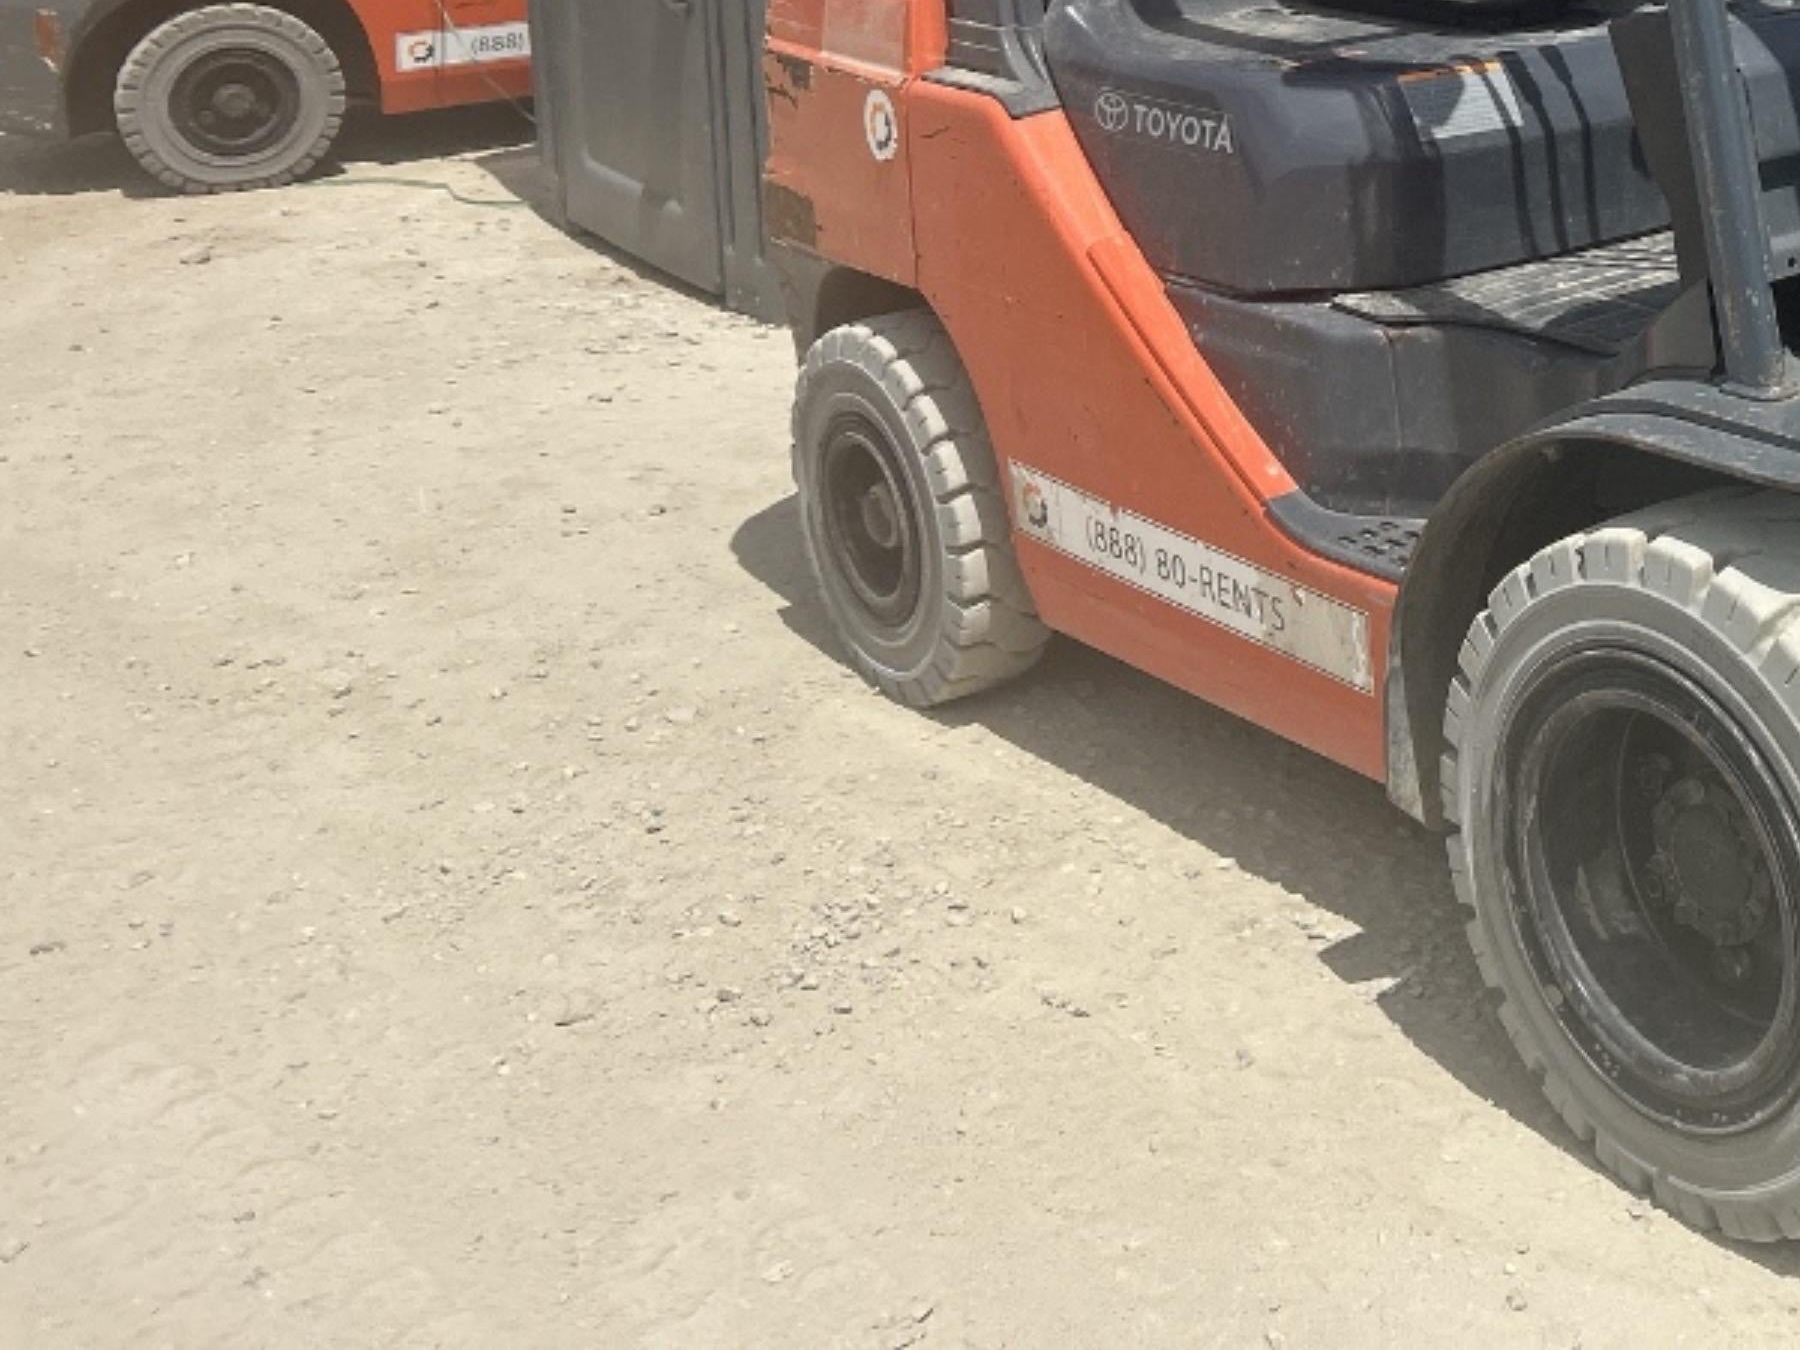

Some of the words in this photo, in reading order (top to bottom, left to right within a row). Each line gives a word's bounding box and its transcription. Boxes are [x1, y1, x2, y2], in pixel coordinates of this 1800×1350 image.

[1133, 103, 1234, 154] TOYOTA
[1085, 514, 1147, 575] (888)
[1157, 548, 1285, 631] 80-RENTS
